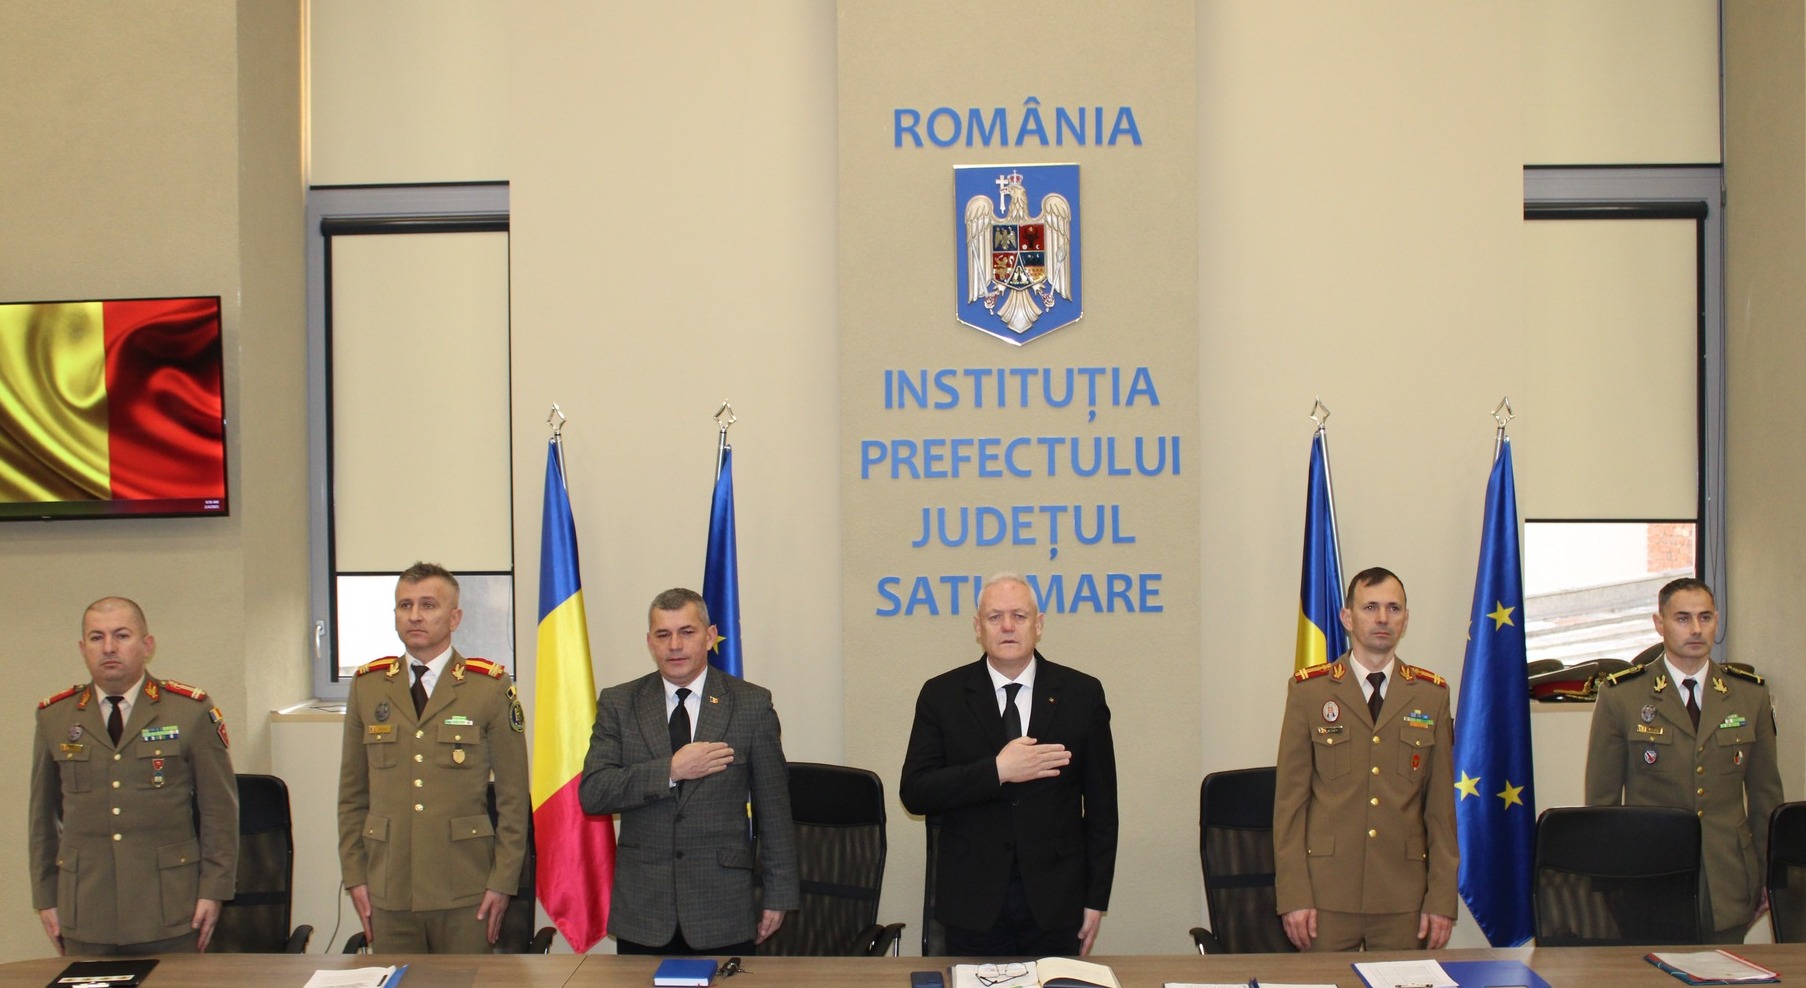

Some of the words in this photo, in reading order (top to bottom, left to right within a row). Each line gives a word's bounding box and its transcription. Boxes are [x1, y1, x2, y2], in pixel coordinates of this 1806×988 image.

[894, 97, 1142, 147] ROMÂNIA
[885, 366, 1159, 421] INSTITUȚIA
[862, 436, 1181, 479] PREFECTULUI
[911, 504, 1136, 559] JUDEȚUL
[876, 576, 983, 616] SAT
[1025, 573, 1164, 614] MARE
